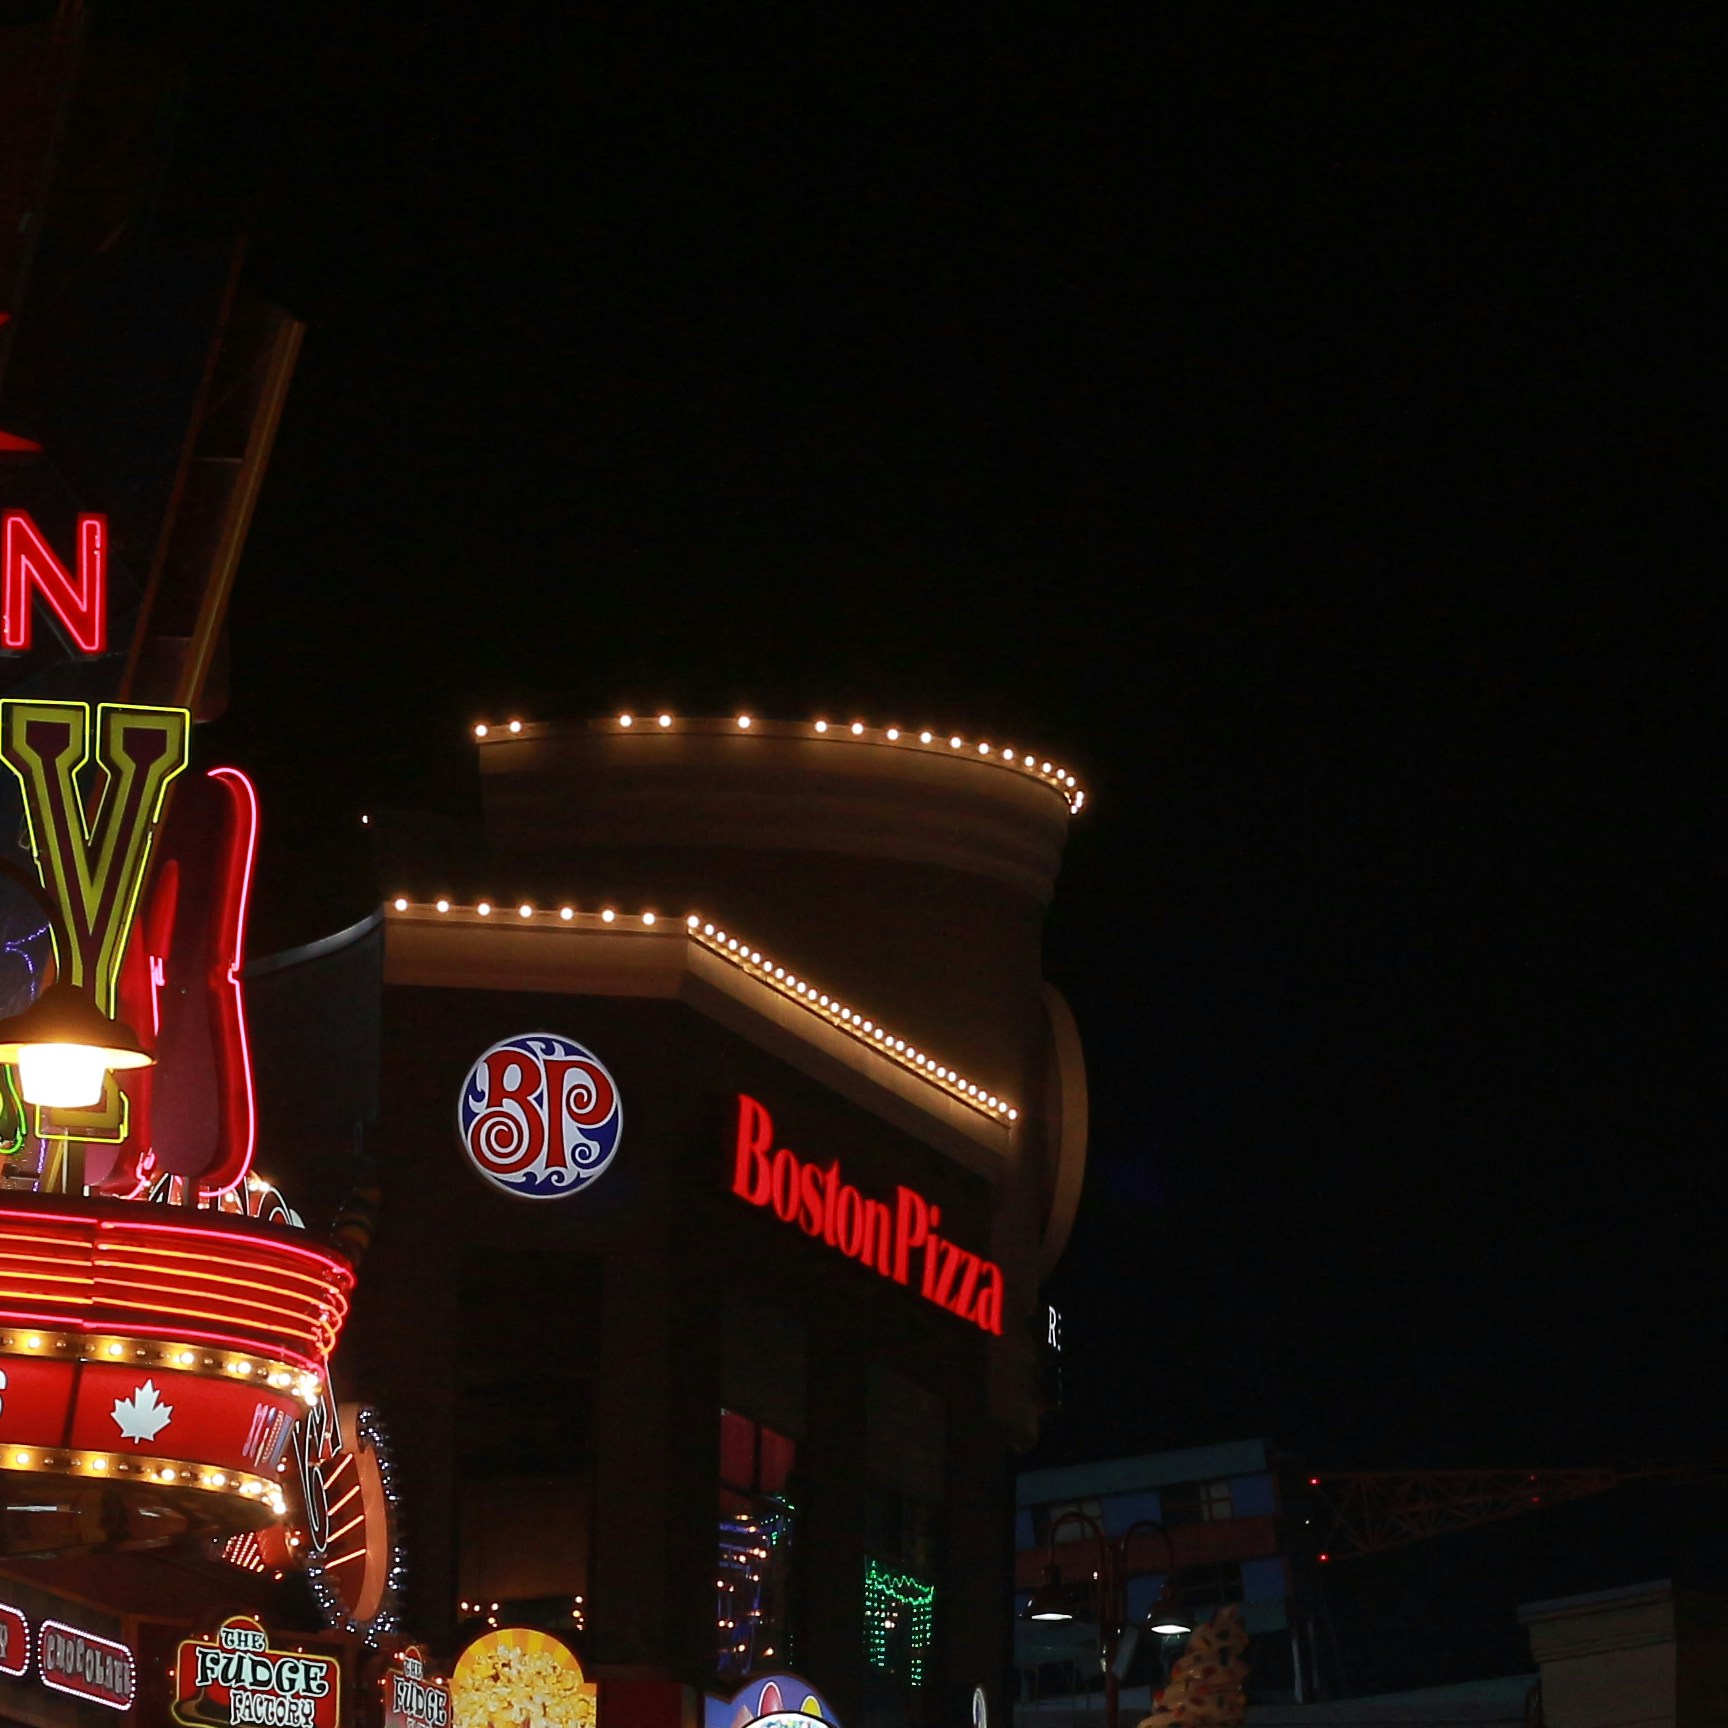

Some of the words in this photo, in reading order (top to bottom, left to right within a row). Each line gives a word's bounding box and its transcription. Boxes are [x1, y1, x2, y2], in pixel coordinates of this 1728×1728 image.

[469, 1048, 616, 1175] BP
[221, 1627, 266, 1652] THE
[195, 1646, 329, 1697] FUDGE
[403, 1656, 424, 1681] THE
[229, 1689, 316, 1728] FACTORY
[392, 1676, 448, 1728] FUDGE
